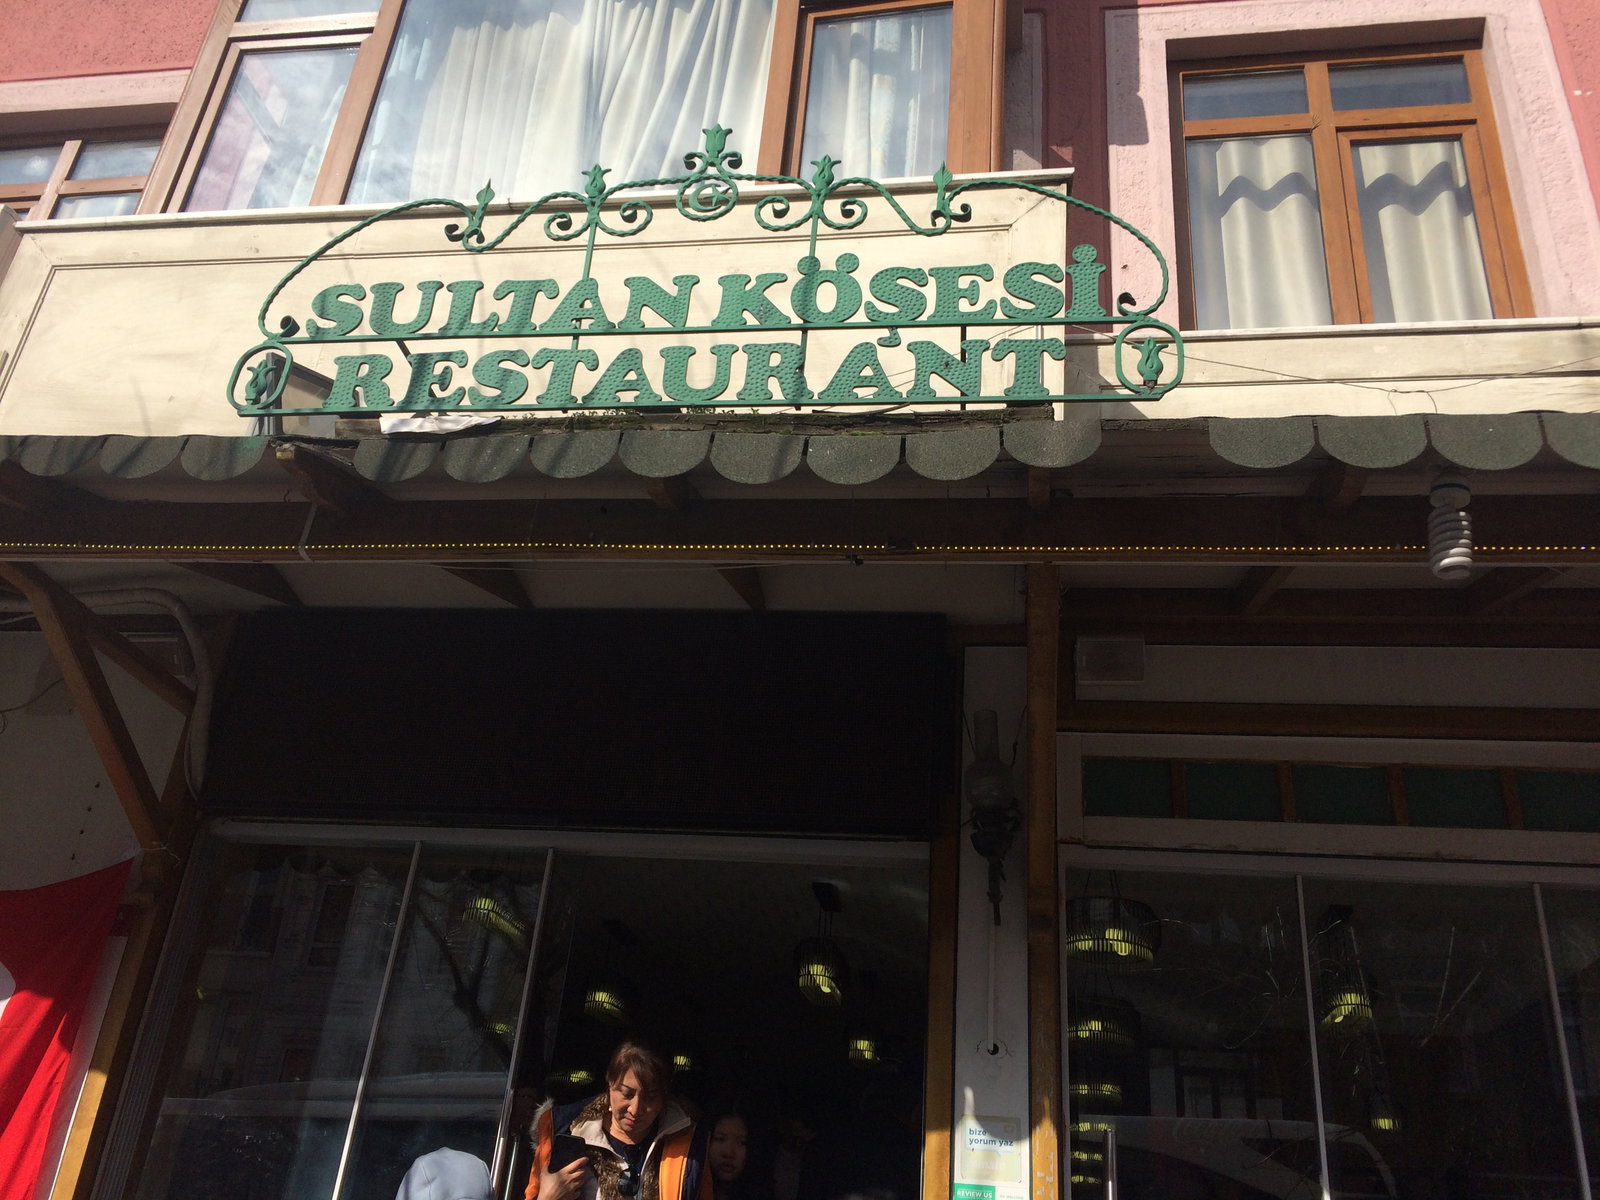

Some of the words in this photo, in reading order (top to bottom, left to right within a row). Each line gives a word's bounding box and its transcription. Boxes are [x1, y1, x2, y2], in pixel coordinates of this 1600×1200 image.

[305, 274, 700, 337] SULTAN
[322, 338, 1066, 408] RESTAURANT
[969, 1128, 987, 1136] bize
[969, 1137, 996, 1145] yorum
[998, 1139, 1014, 1147] yaz
[957, 1190, 982, 1198] REVIEW
